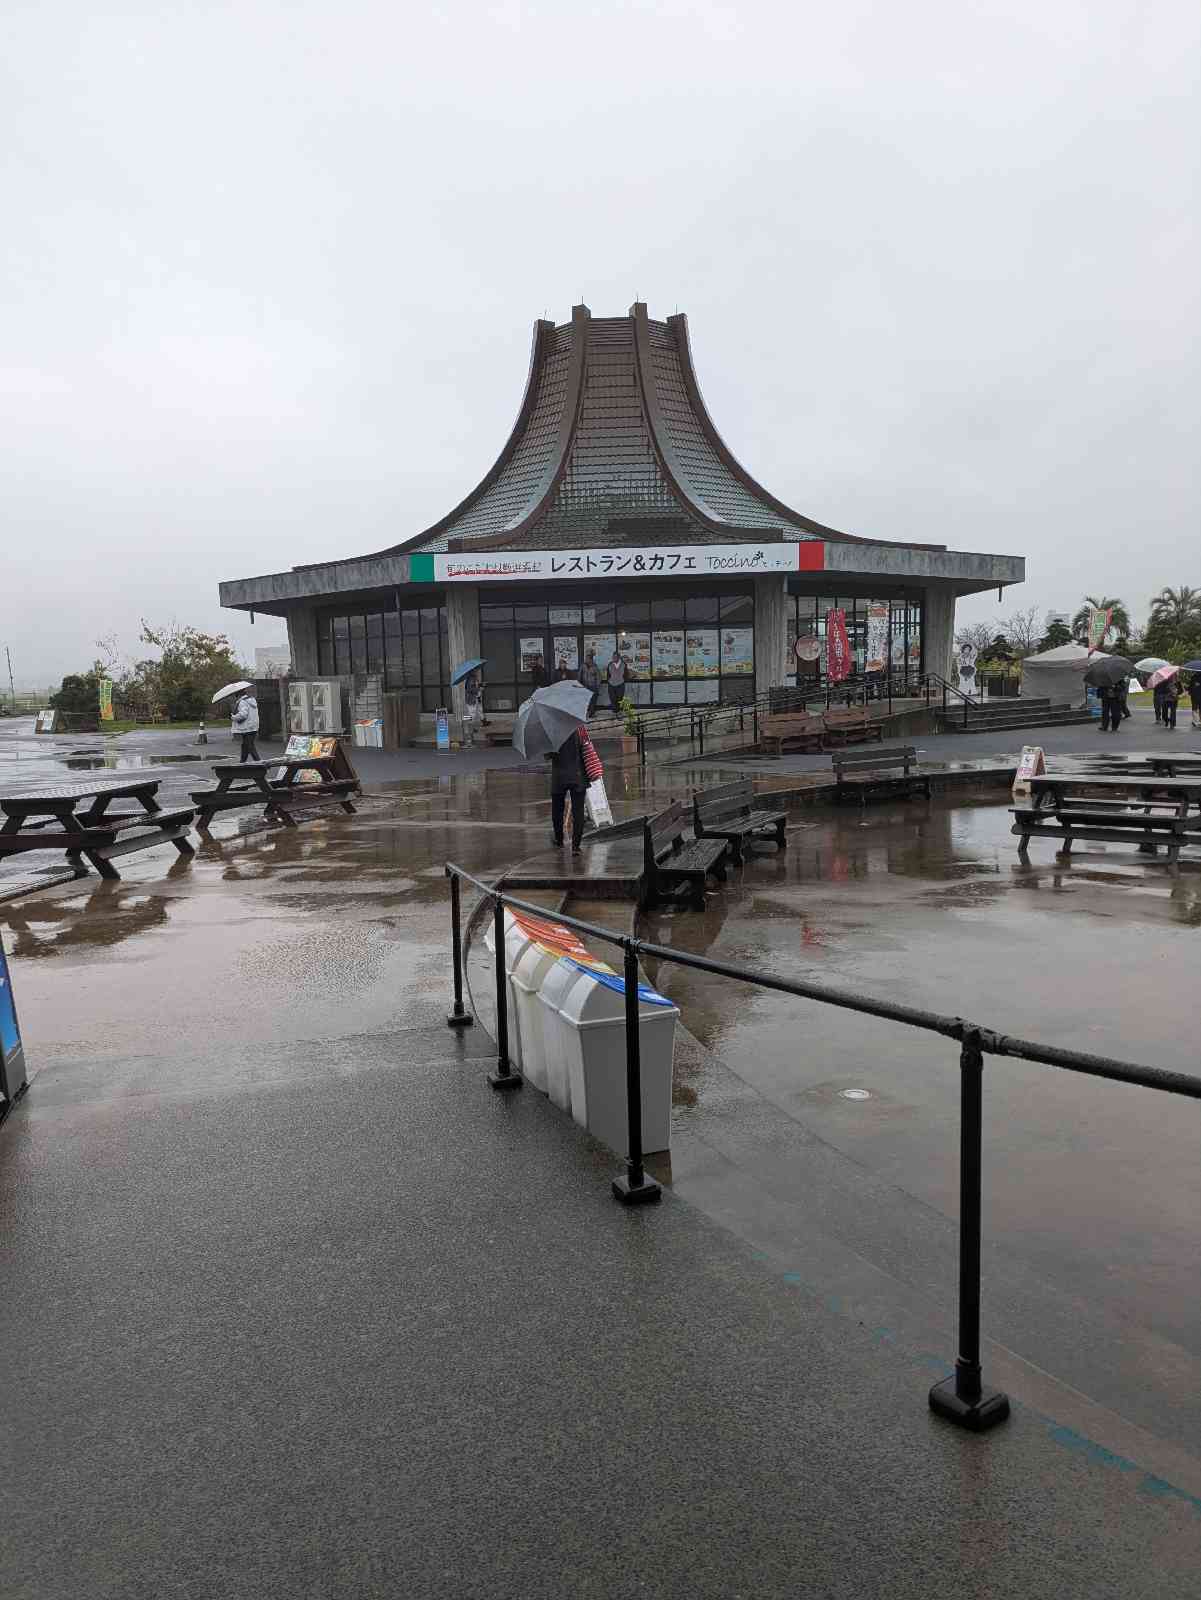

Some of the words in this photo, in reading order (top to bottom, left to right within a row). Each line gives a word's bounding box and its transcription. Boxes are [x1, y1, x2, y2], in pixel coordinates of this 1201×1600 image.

[551, 553, 697, 573] レストラン&カフェ
